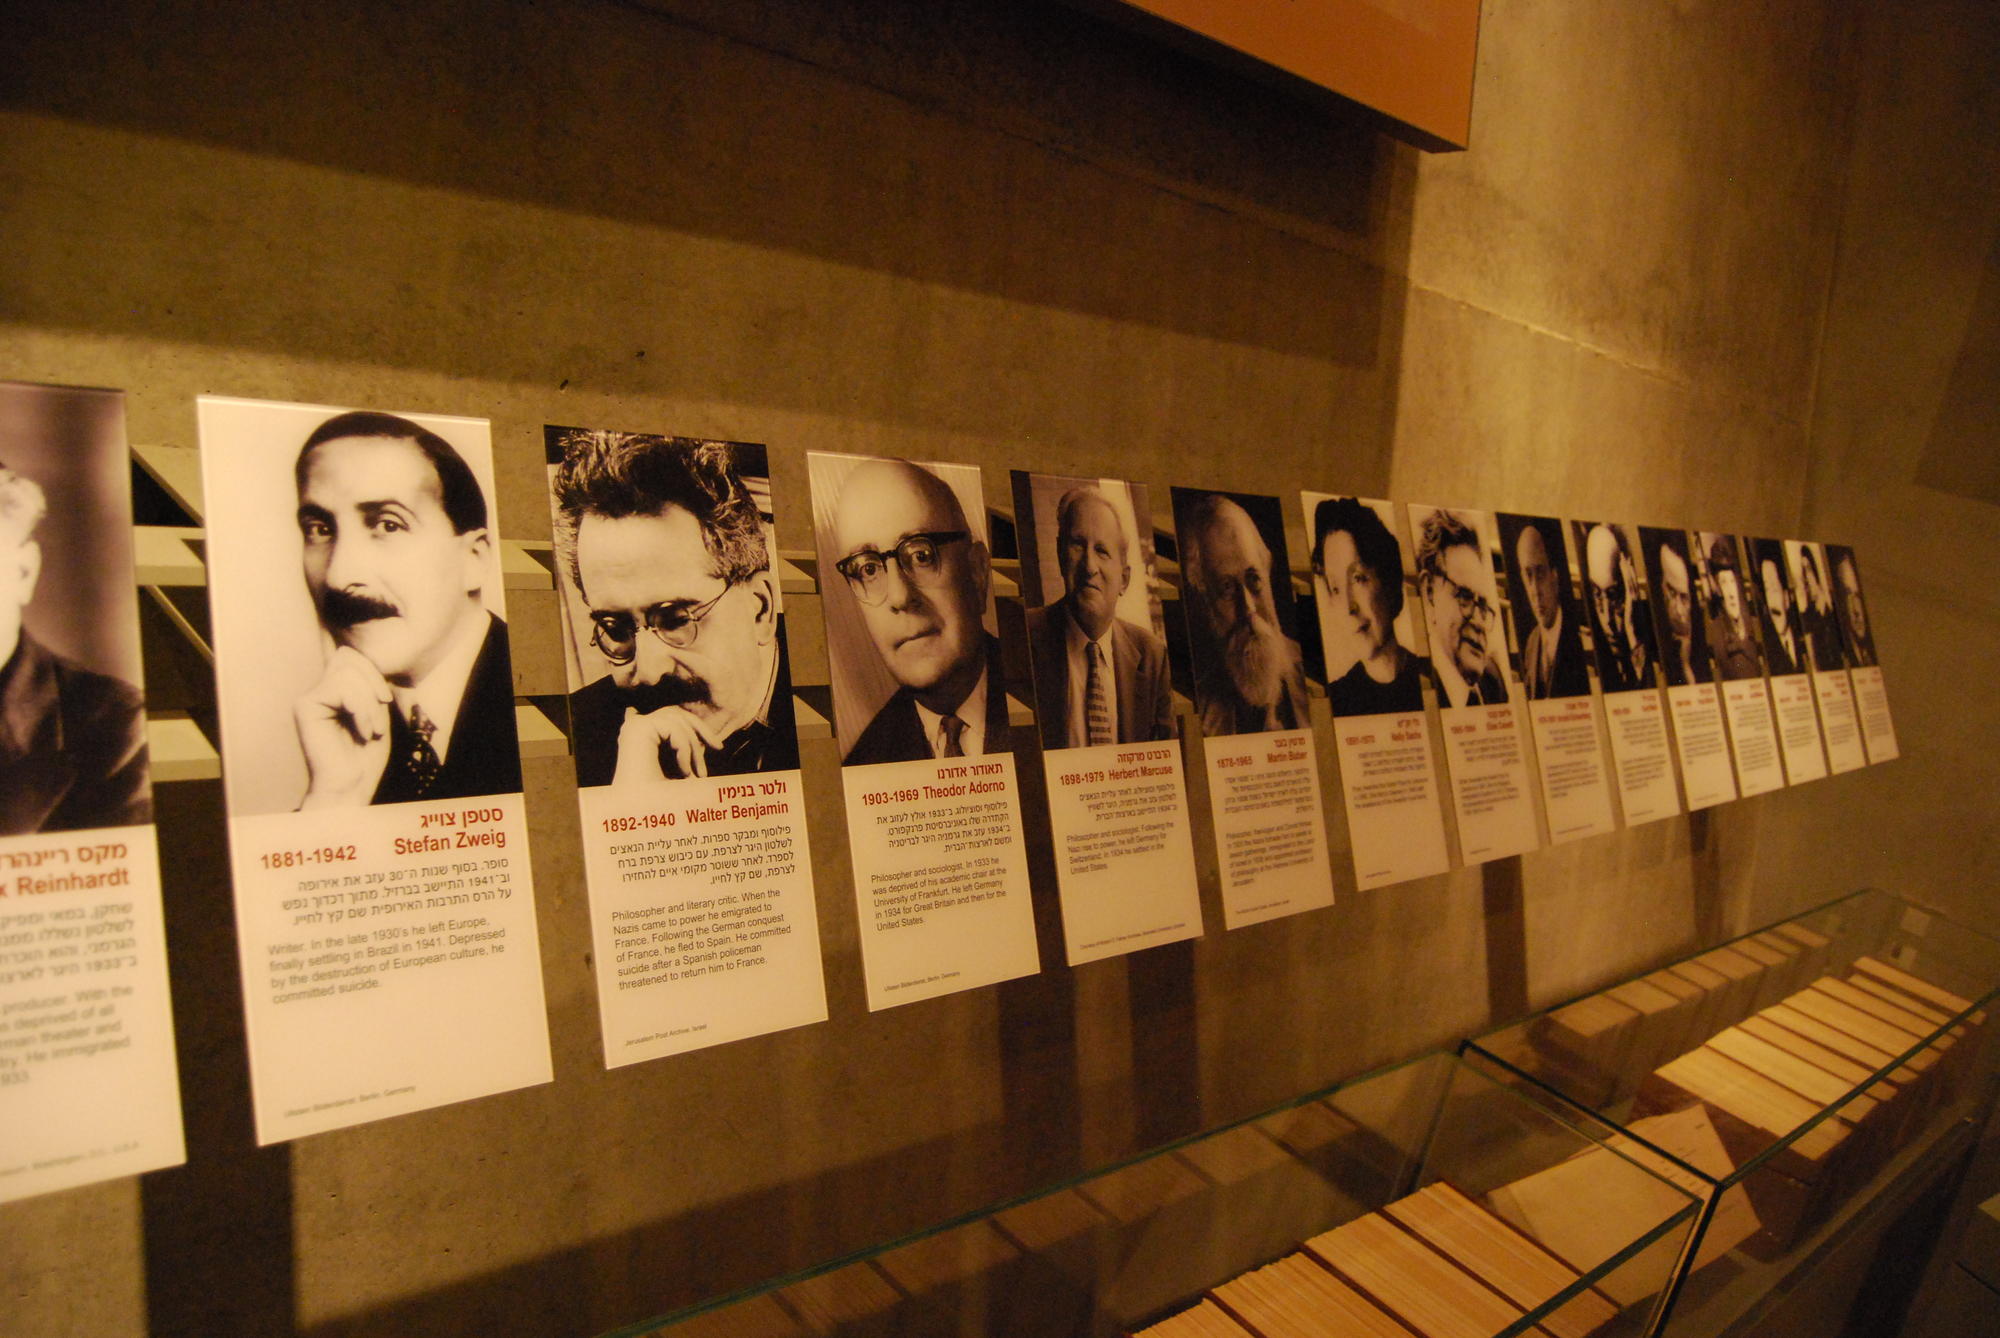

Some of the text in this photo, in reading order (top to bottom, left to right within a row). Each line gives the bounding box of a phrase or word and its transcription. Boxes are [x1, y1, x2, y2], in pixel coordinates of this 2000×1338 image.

[1060, 766, 1172, 785] 1898-1979 Herbert Marcuse
[718, 779, 786, 803] ולטר בנימין
[862, 781, 1005, 805] 1903-1969 Theodor Adorno
[420, 808, 503, 827] סטפן צוייג
[603, 801, 788, 832] 1892-1940 Walter Benjamin
[260, 829, 506, 868] 1881-1942 Stefan Zweig
[17, 868, 128, 895] Reinhardt
[871, 871, 912, 883] Philosopher
[914, 868, 926, 877] and
[974, 857, 989, 866] 1933
[872, 887, 886, 895] was
[888, 881, 918, 893] deprived
[919, 879, 926, 887] of
[939, 873, 970, 884] academic
[972, 871, 987, 879] chair
[989, 868, 995, 876] at
[612, 906, 665, 921] Philosopher
[668, 902, 684, 913] and
[686, 900, 715, 909] literary
[741, 892, 765, 901] When
[767, 889, 780, 898] the
[873, 895, 908, 907] University
[909, 892, 916, 901] of
[962, 883, 972, 891] left
[974, 880, 1003, 890] Germany
[884, 907, 901, 917] 1934
[902, 906, 912, 914] for
[913, 902, 933, 912] Great
[934, 899, 955, 909] Britain
[957, 896, 969, 904] and
[970, 894, 985, 902] then
[613, 925, 639, 934] Nazis
[641, 920, 666, 930] came
[668, 918, 677, 926] to
[679, 914, 705, 926] power
[721, 904, 762, 918] emigrated
[763, 903, 772, 911] to
[652, 929, 693, 942] Following
[695, 927, 709, 935] the
[711, 921, 745, 932] German
[747, 913, 784, 927] conquest
[876, 920, 900, 931] United
[269, 959, 303, 971] finally
[308, 953, 350, 966] settling
[354, 950, 363, 959] in
[367, 944, 398, 957] Brazil
[402, 943, 412, 951] in
[449, 928, 505, 945] Depressed
[616, 952, 625, 963] of
[678, 941, 694, 951] fled
[696, 941, 704, 949] to
[736, 933, 747, 941] He
[750, 924, 791, 940] committed
[270, 978, 285, 989] by
[289, 975, 307, 984] the
[312, 964, 375, 981] destruction
[379, 960, 390, 971] of
[393, 954, 447, 969] European
[491, 944, 504, 953] he
[617, 963, 649, 976] suicide
[652, 960, 672, 970] after
[682, 951, 717, 965] Spanish
[719, 944, 761, 960] policeman
[618, 972, 668, 990] threatened
[670, 972, 679, 980] to
[680, 967, 706, 978] return
[708, 964, 724, 973] him
[726, 962, 734, 970] to
